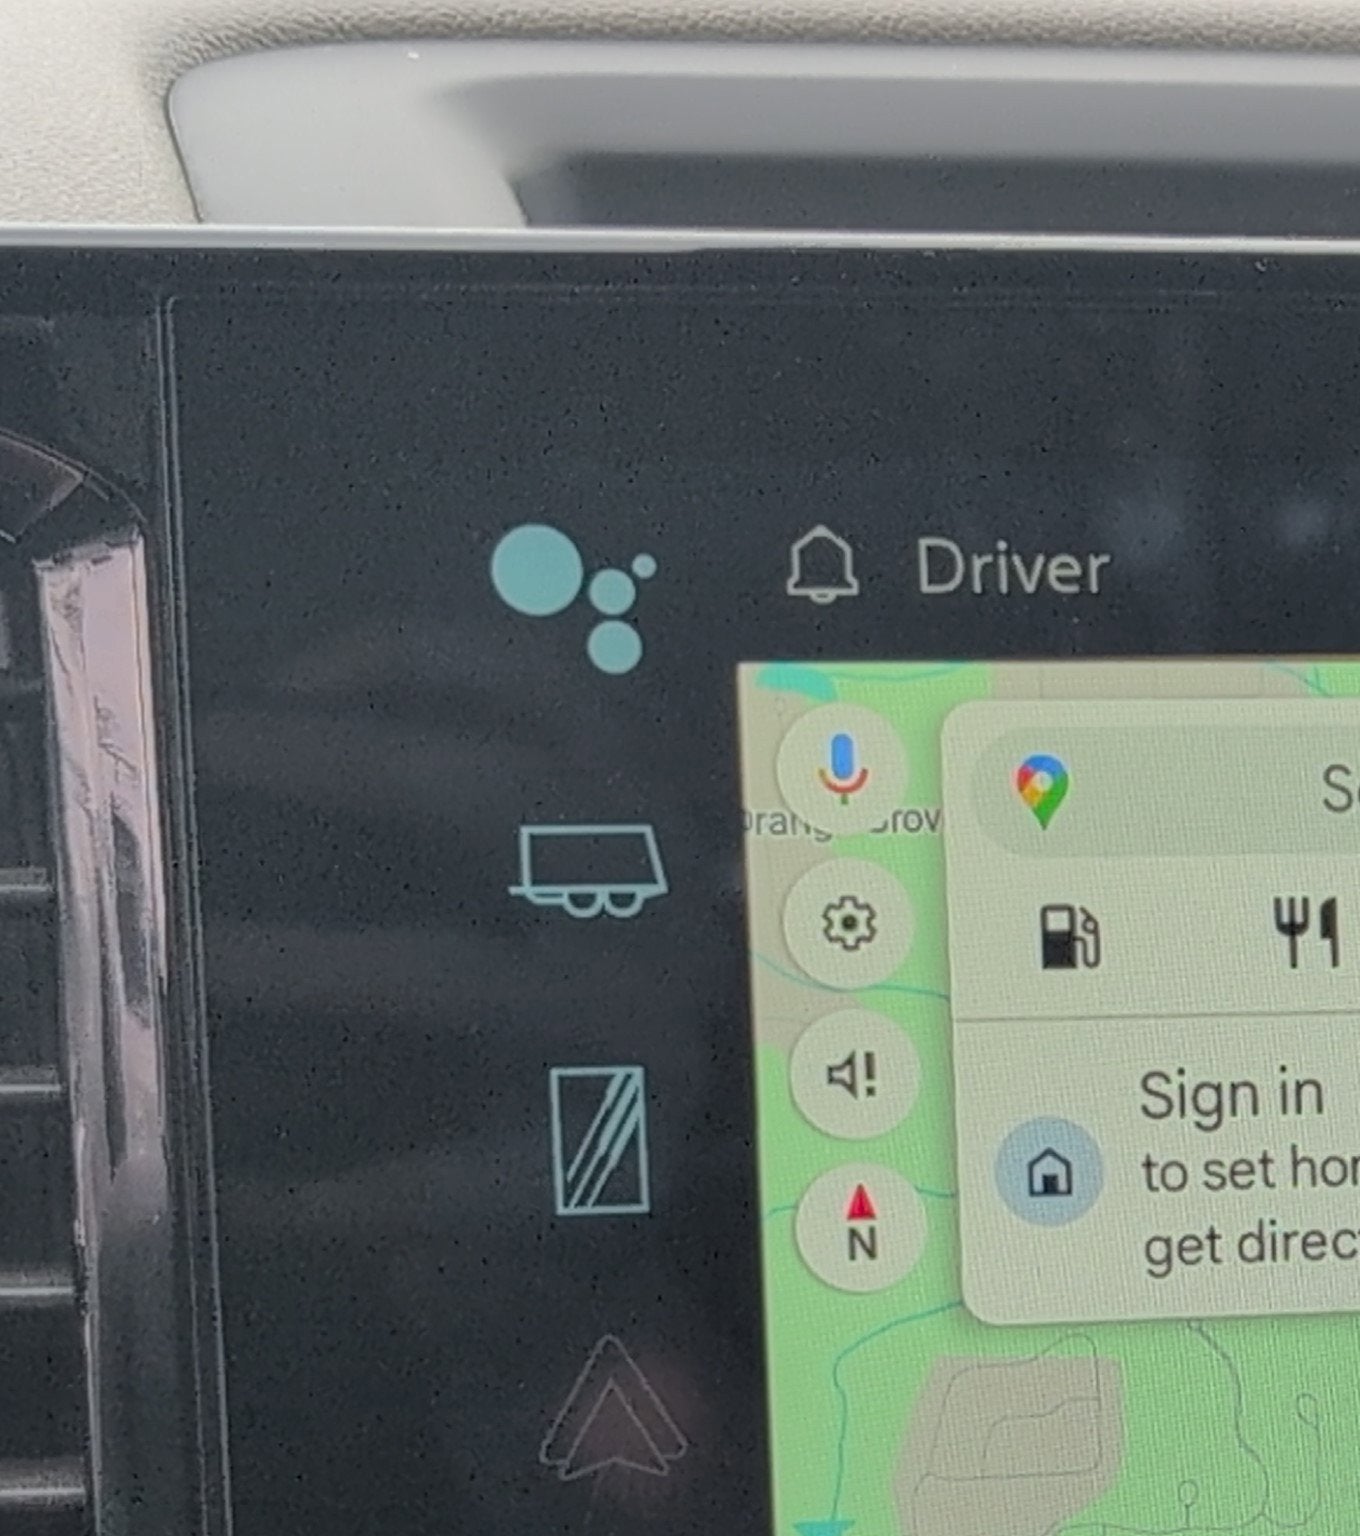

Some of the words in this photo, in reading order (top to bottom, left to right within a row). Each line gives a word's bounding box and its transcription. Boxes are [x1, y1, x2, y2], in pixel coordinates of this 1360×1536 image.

[916, 537, 1111, 595] Driver
[1140, 1068, 1260, 1132] Sign
[1279, 1064, 1325, 1117] in
[1141, 1153, 1189, 1193] to
[1203, 1148, 1276, 1191] set
[847, 1227, 879, 1262] N
[1143, 1224, 1223, 1279] get
